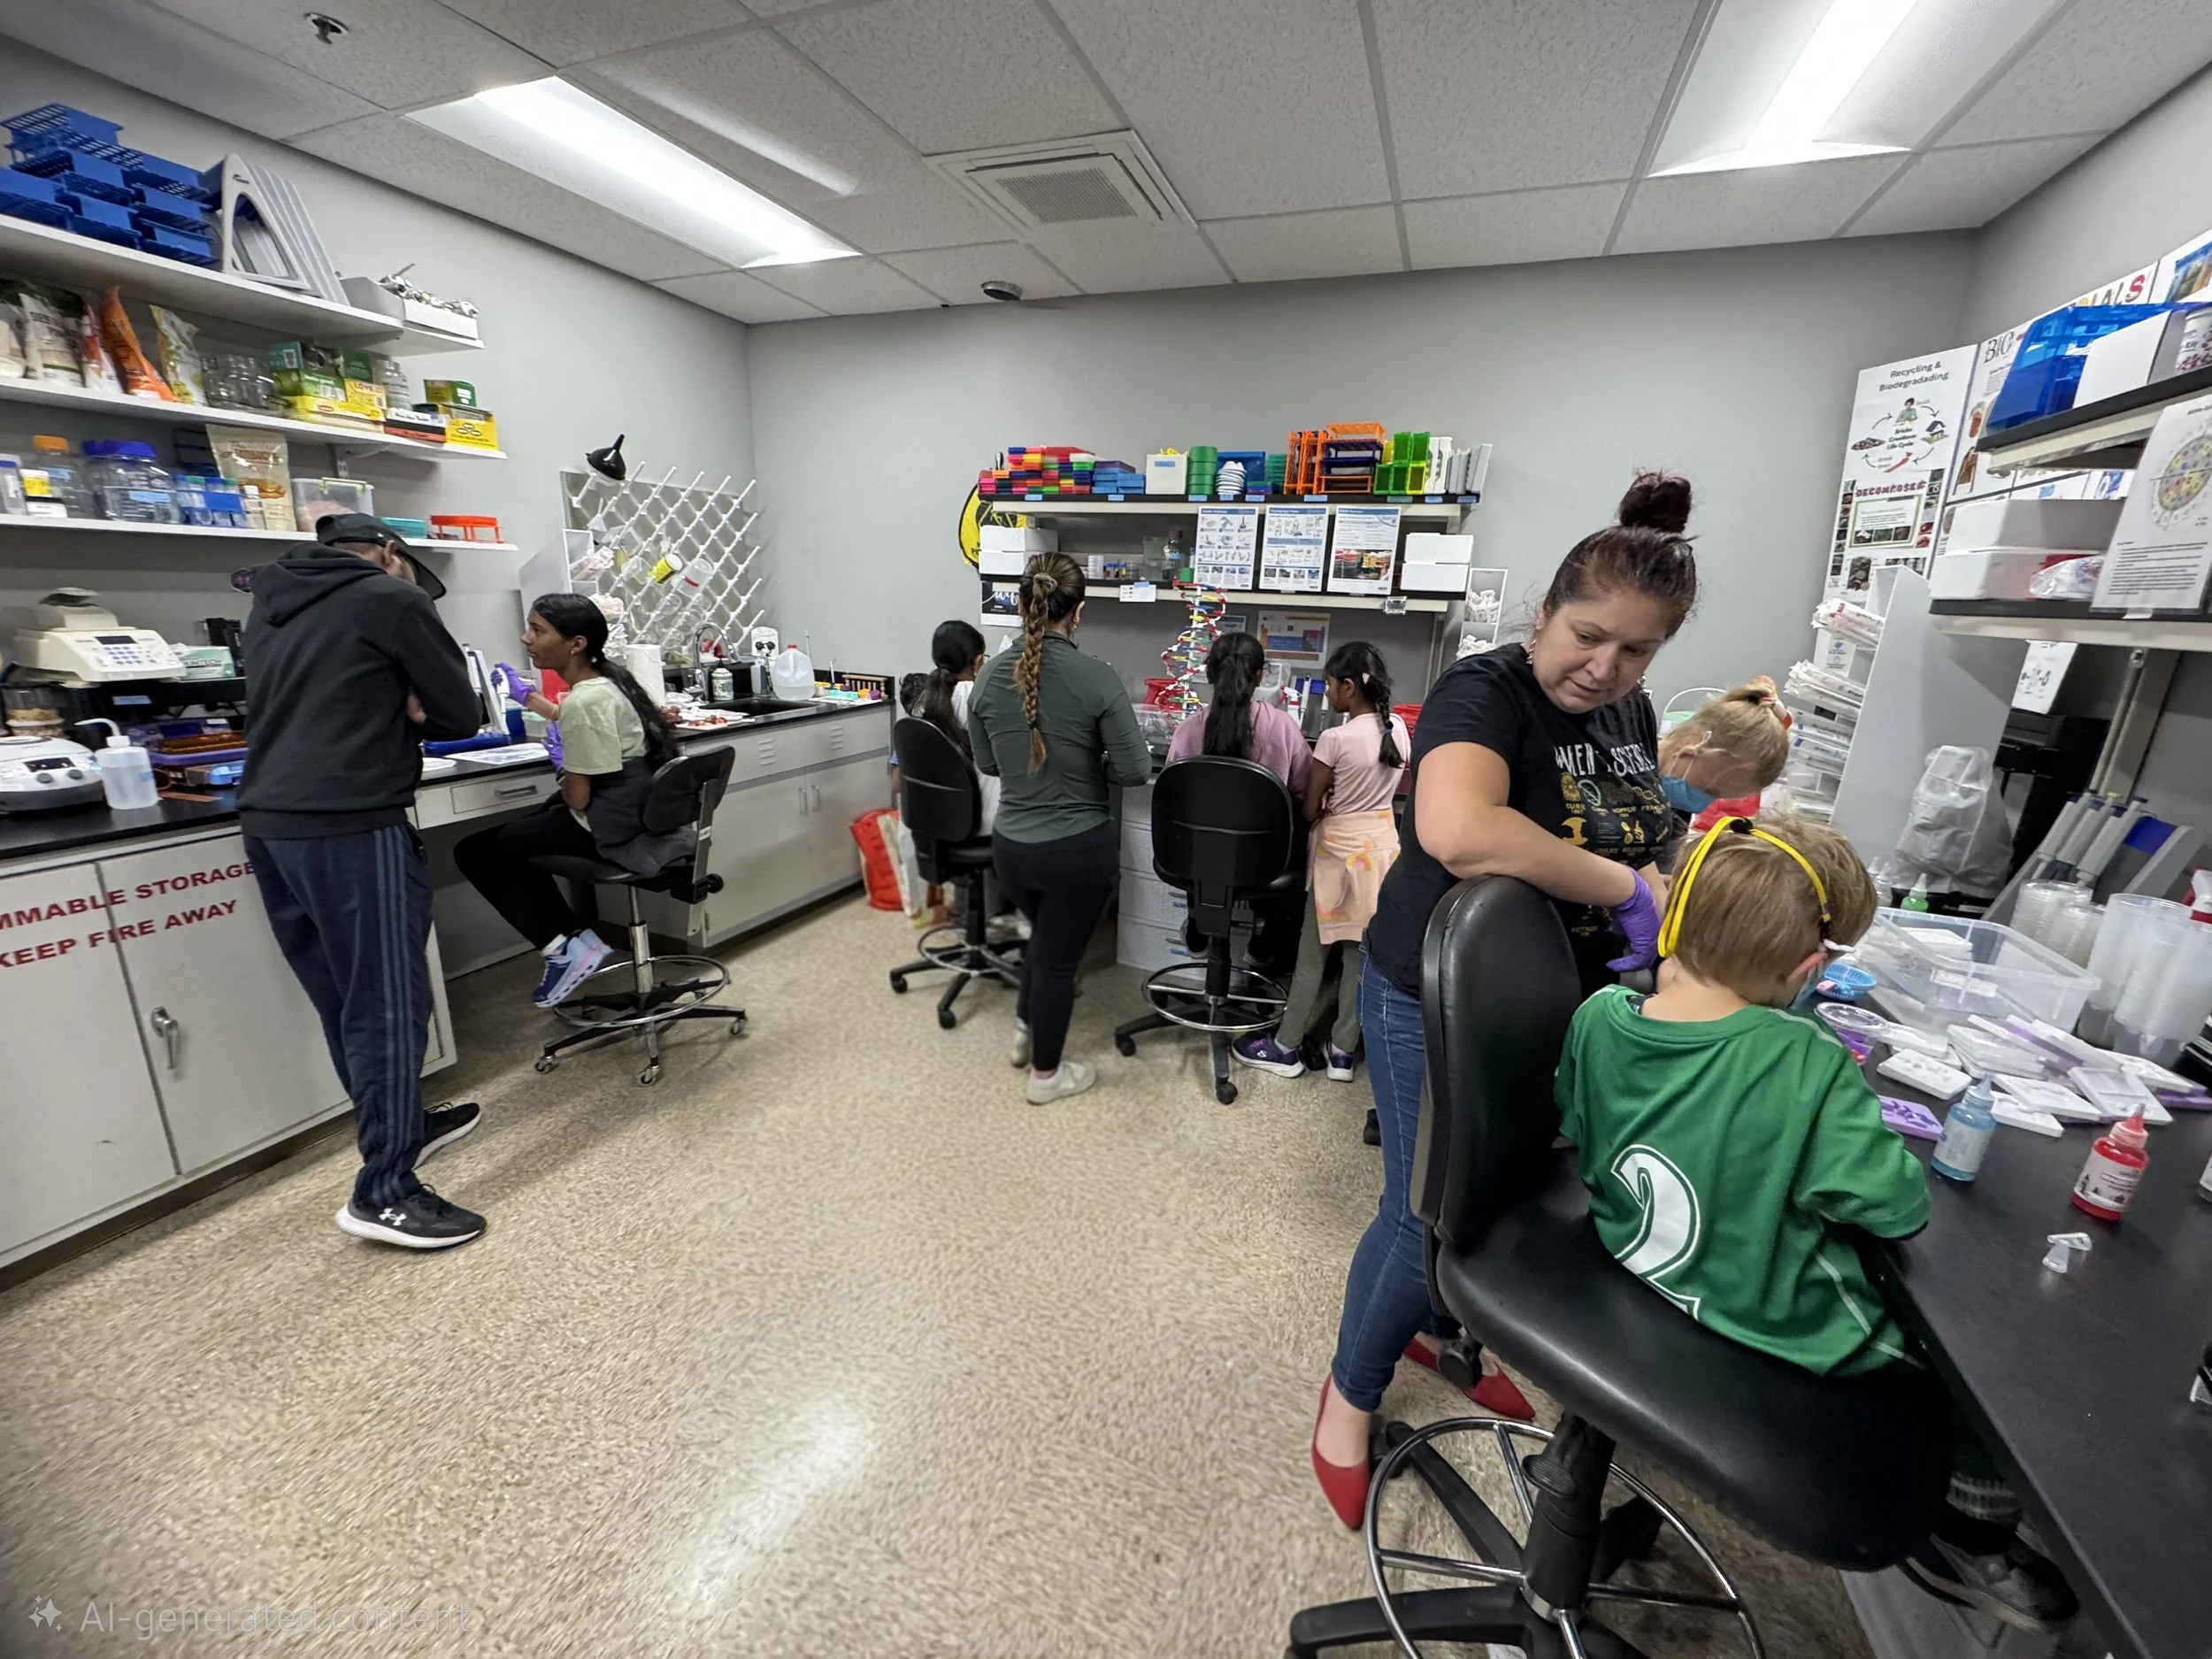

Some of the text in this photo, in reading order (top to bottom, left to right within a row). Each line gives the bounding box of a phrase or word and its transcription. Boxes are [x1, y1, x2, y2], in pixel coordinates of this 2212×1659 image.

[1890, 364, 1933, 379] Recycling
[88, 919, 157, 949] FIRE
[164, 899, 238, 930] AWAY
